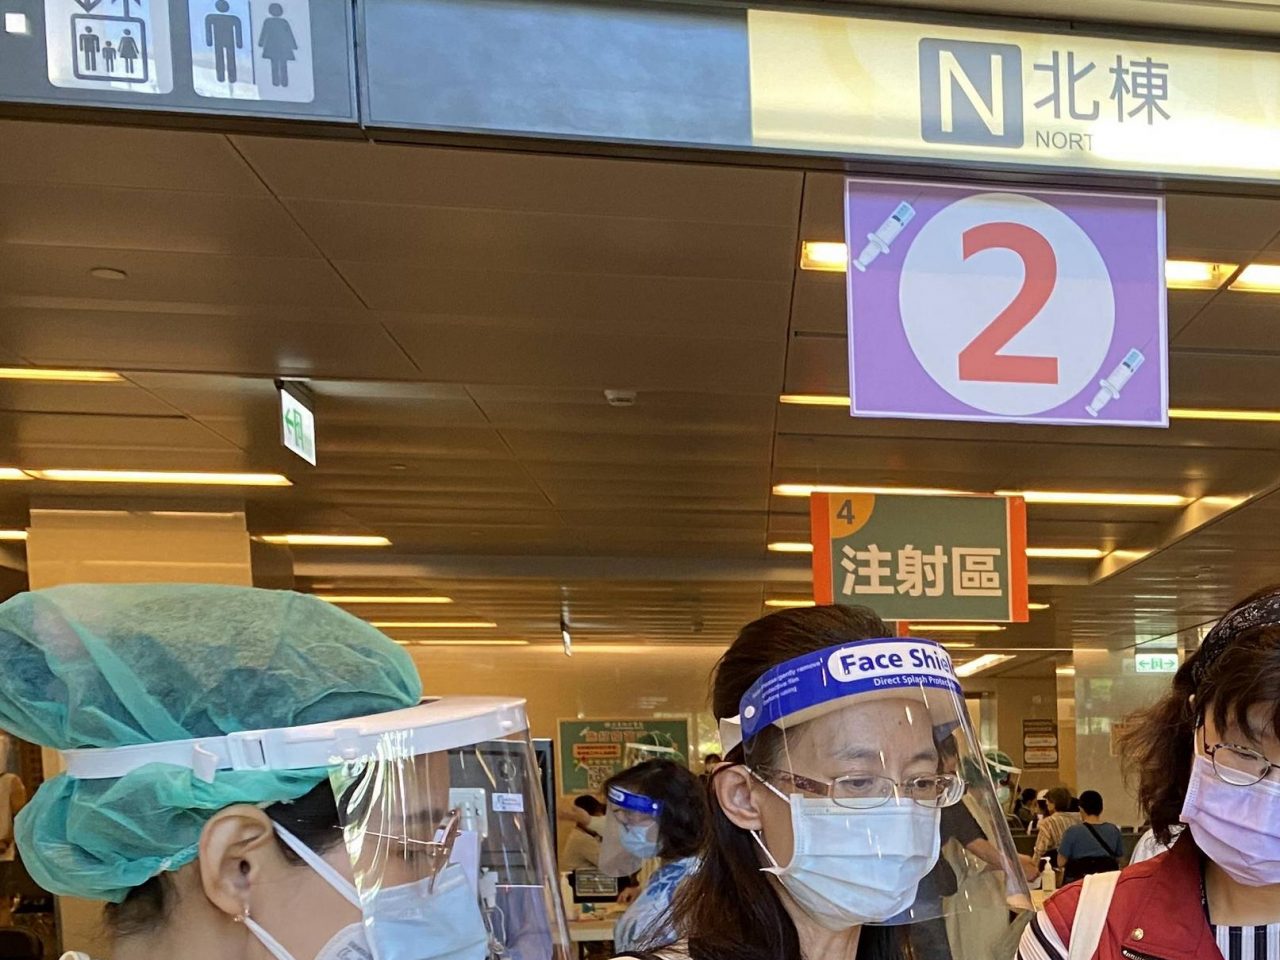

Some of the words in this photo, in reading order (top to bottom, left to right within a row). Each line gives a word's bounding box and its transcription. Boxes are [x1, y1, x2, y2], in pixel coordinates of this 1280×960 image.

[939, 50, 1005, 137] N
[1033, 50, 1171, 126] 北棟
[958, 221, 1059, 385] 2
[836, 499, 855, 524] 4
[840, 543, 1003, 597] 注射區
[840, 652, 903, 677] Face
[873, 675, 901, 687] Direct
[902, 674, 928, 686] Splash
